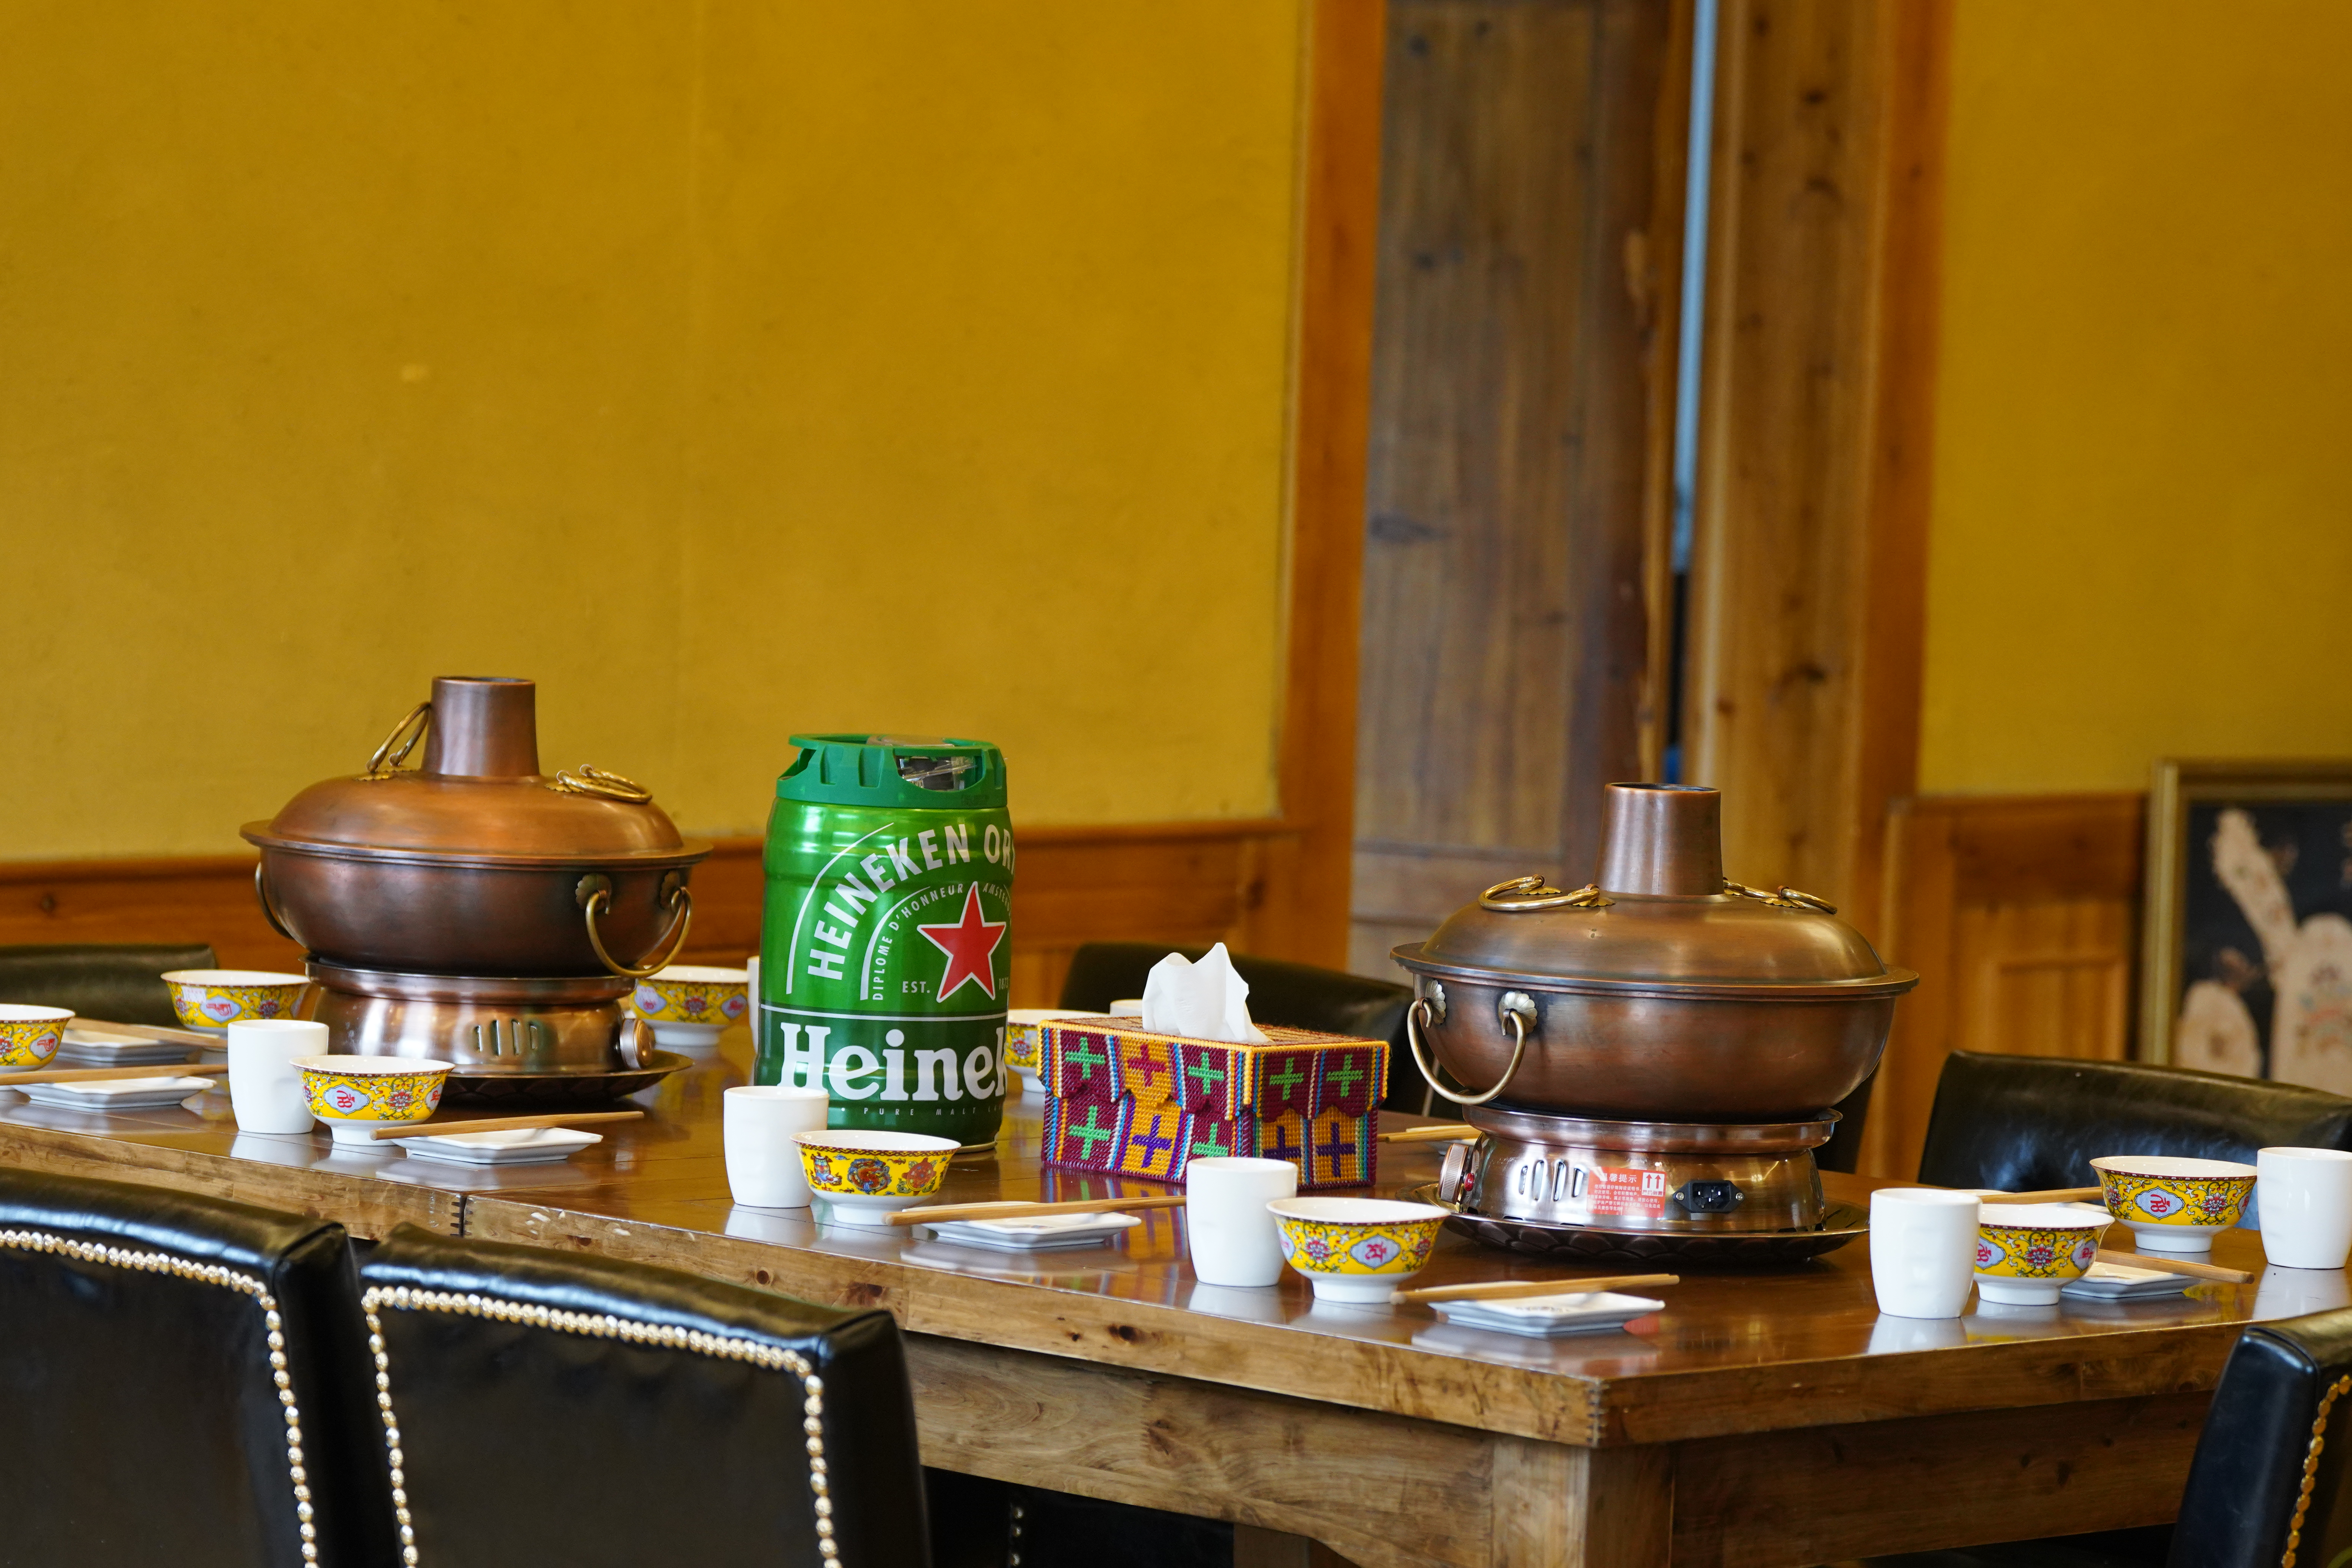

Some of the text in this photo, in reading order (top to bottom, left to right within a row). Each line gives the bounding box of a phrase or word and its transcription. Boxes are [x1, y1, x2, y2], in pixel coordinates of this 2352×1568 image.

[808, 824, 970, 980] HEINEKEN
[872, 884, 963, 1000] DIPLOME D'HONNEUR
[902, 981, 930, 993] EST.
[864, 1106, 975, 1116] PURE MALT
